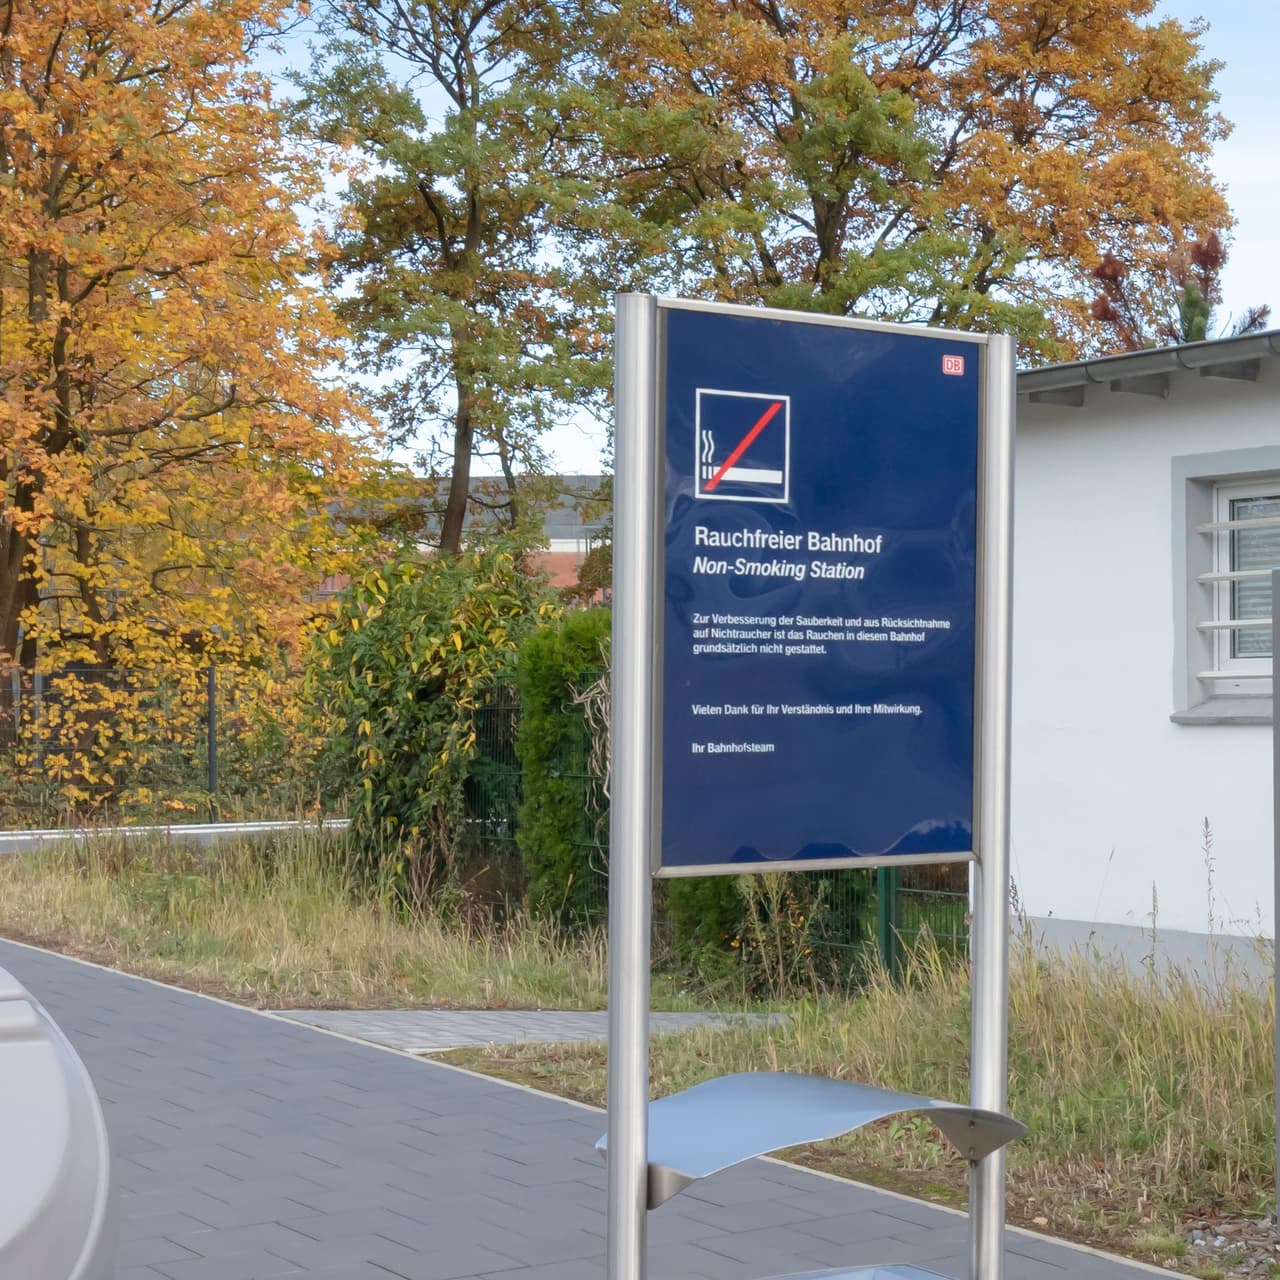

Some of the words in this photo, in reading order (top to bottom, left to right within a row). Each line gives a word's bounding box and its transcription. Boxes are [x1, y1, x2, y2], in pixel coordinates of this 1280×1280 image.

[945, 357, 962, 373] DB
[695, 526, 803, 550] Rauchfreier
[807, 531, 882, 554] Bahnhof
[693, 556, 806, 581] Non-Smoking
[810, 560, 865, 580] Station
[693, 613, 710, 624] Zur
[712, 613, 777, 627] Verbesserung
[778, 615, 794, 626] der
[796, 616, 843, 627] Sauberkeit
[845, 617, 862, 627] und
[863, 618, 880, 628] aus
[881, 617, 951, 629] Rücksichtnahme
[693, 627, 709, 639] auf
[711, 628, 772, 639] Nichtraucher
[774, 629, 786, 639] ist
[787, 629, 805, 640] das
[806, 629, 844, 641] Rauchen
[846, 630, 855, 640] in
[856, 631, 888, 641] diesem
[890, 631, 925, 642] Bahnhof
[692, 642, 757, 655] grundsätzlich
[759, 643, 783, 653] nicht
[785, 644, 827, 656] gestattet.
[692, 704, 722, 715] Vielen
[724, 704, 749, 715] Dank
[751, 703, 764, 714] für
[766, 704, 779, 714] Ihr
[781, 703, 834, 714] Verständnis
[836, 704, 853, 714] und
[855, 703, 872, 714] Ihre
[873, 703, 923, 716] Mitwirkung.
[691, 742, 706, 753] Ihr
[707, 742, 775, 753] Bahnhofsteam
